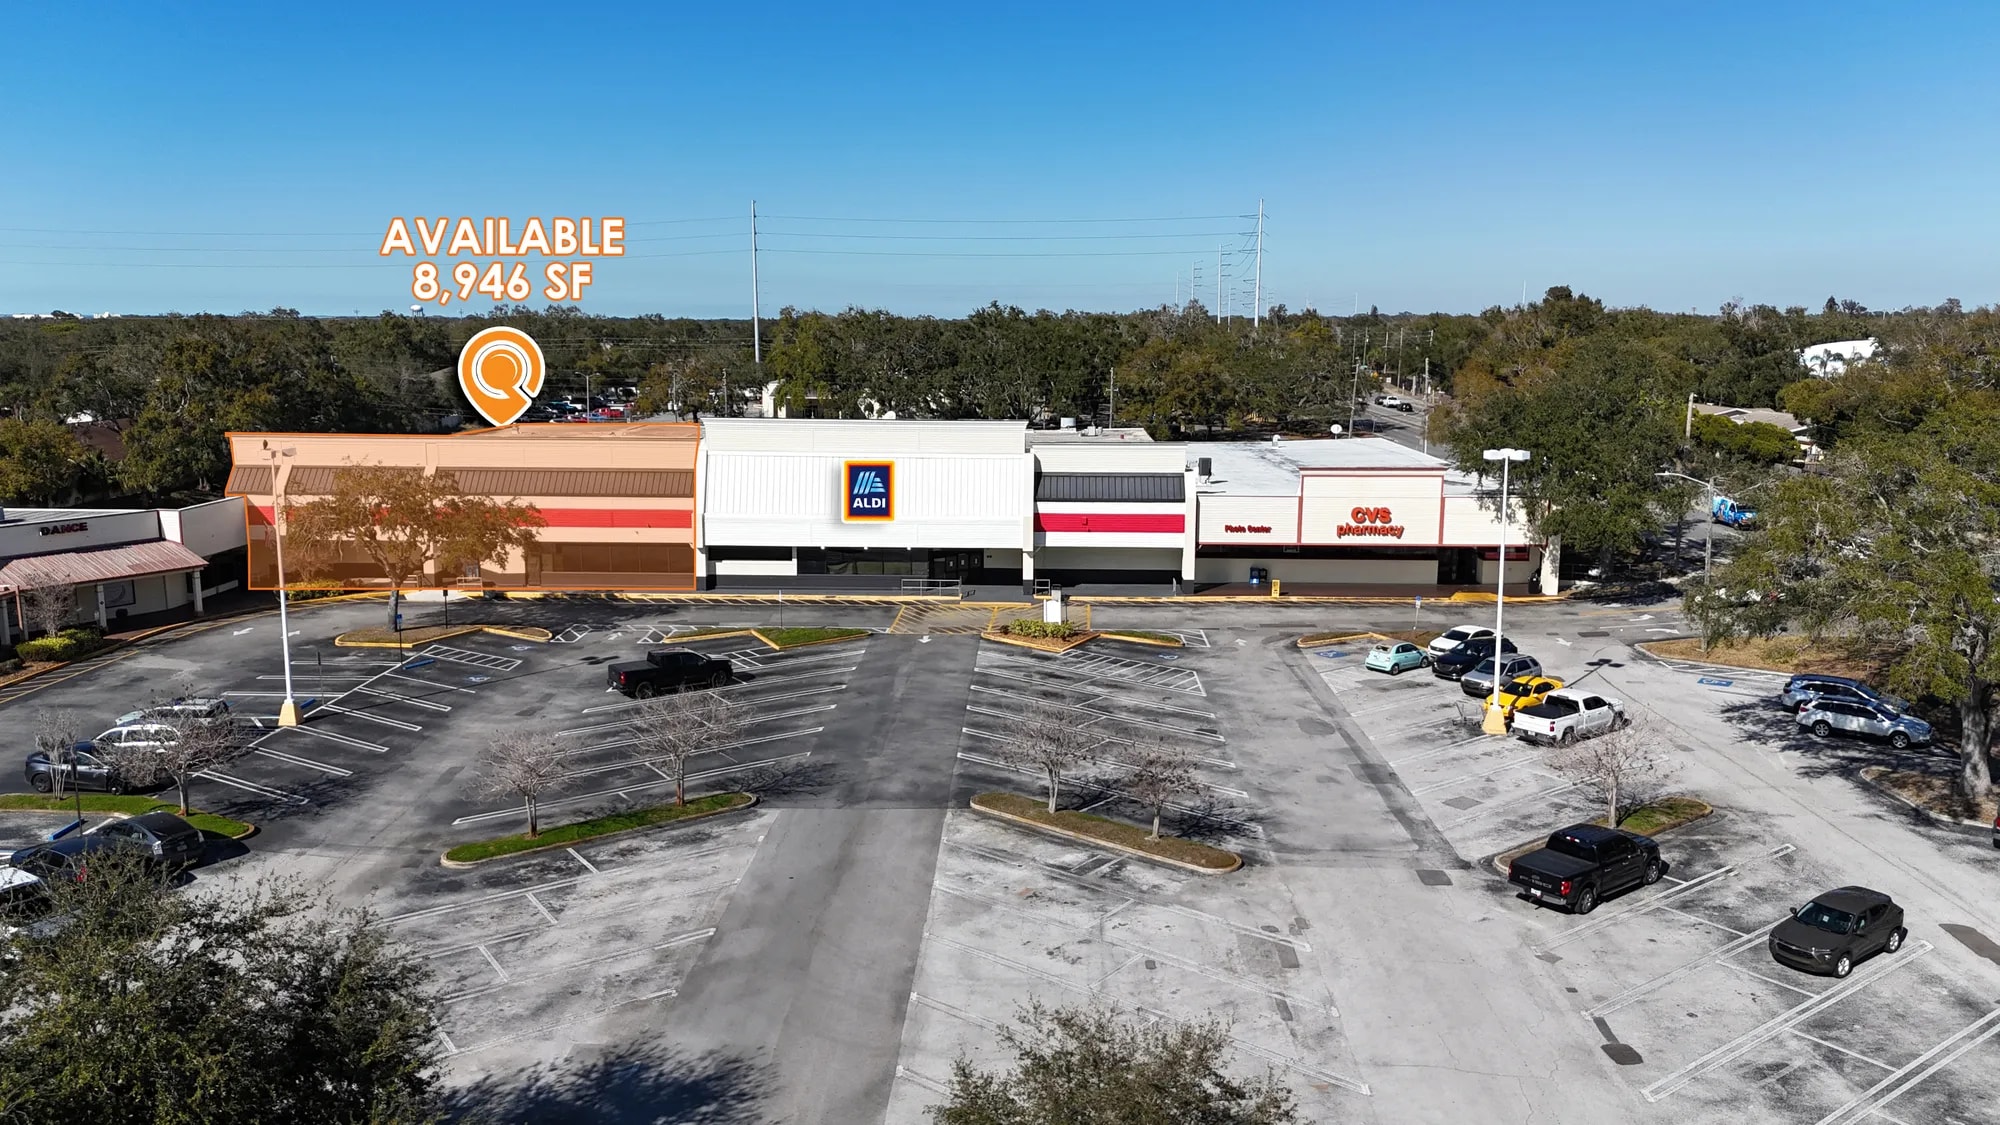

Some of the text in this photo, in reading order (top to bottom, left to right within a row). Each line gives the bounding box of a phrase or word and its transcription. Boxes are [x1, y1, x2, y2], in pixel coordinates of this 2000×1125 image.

[853, 497, 886, 508] ALDI
[1351, 506, 1392, 524] CVS
[40, 522, 88, 536] DANCE
[1336, 522, 1405, 539] pharmacy
